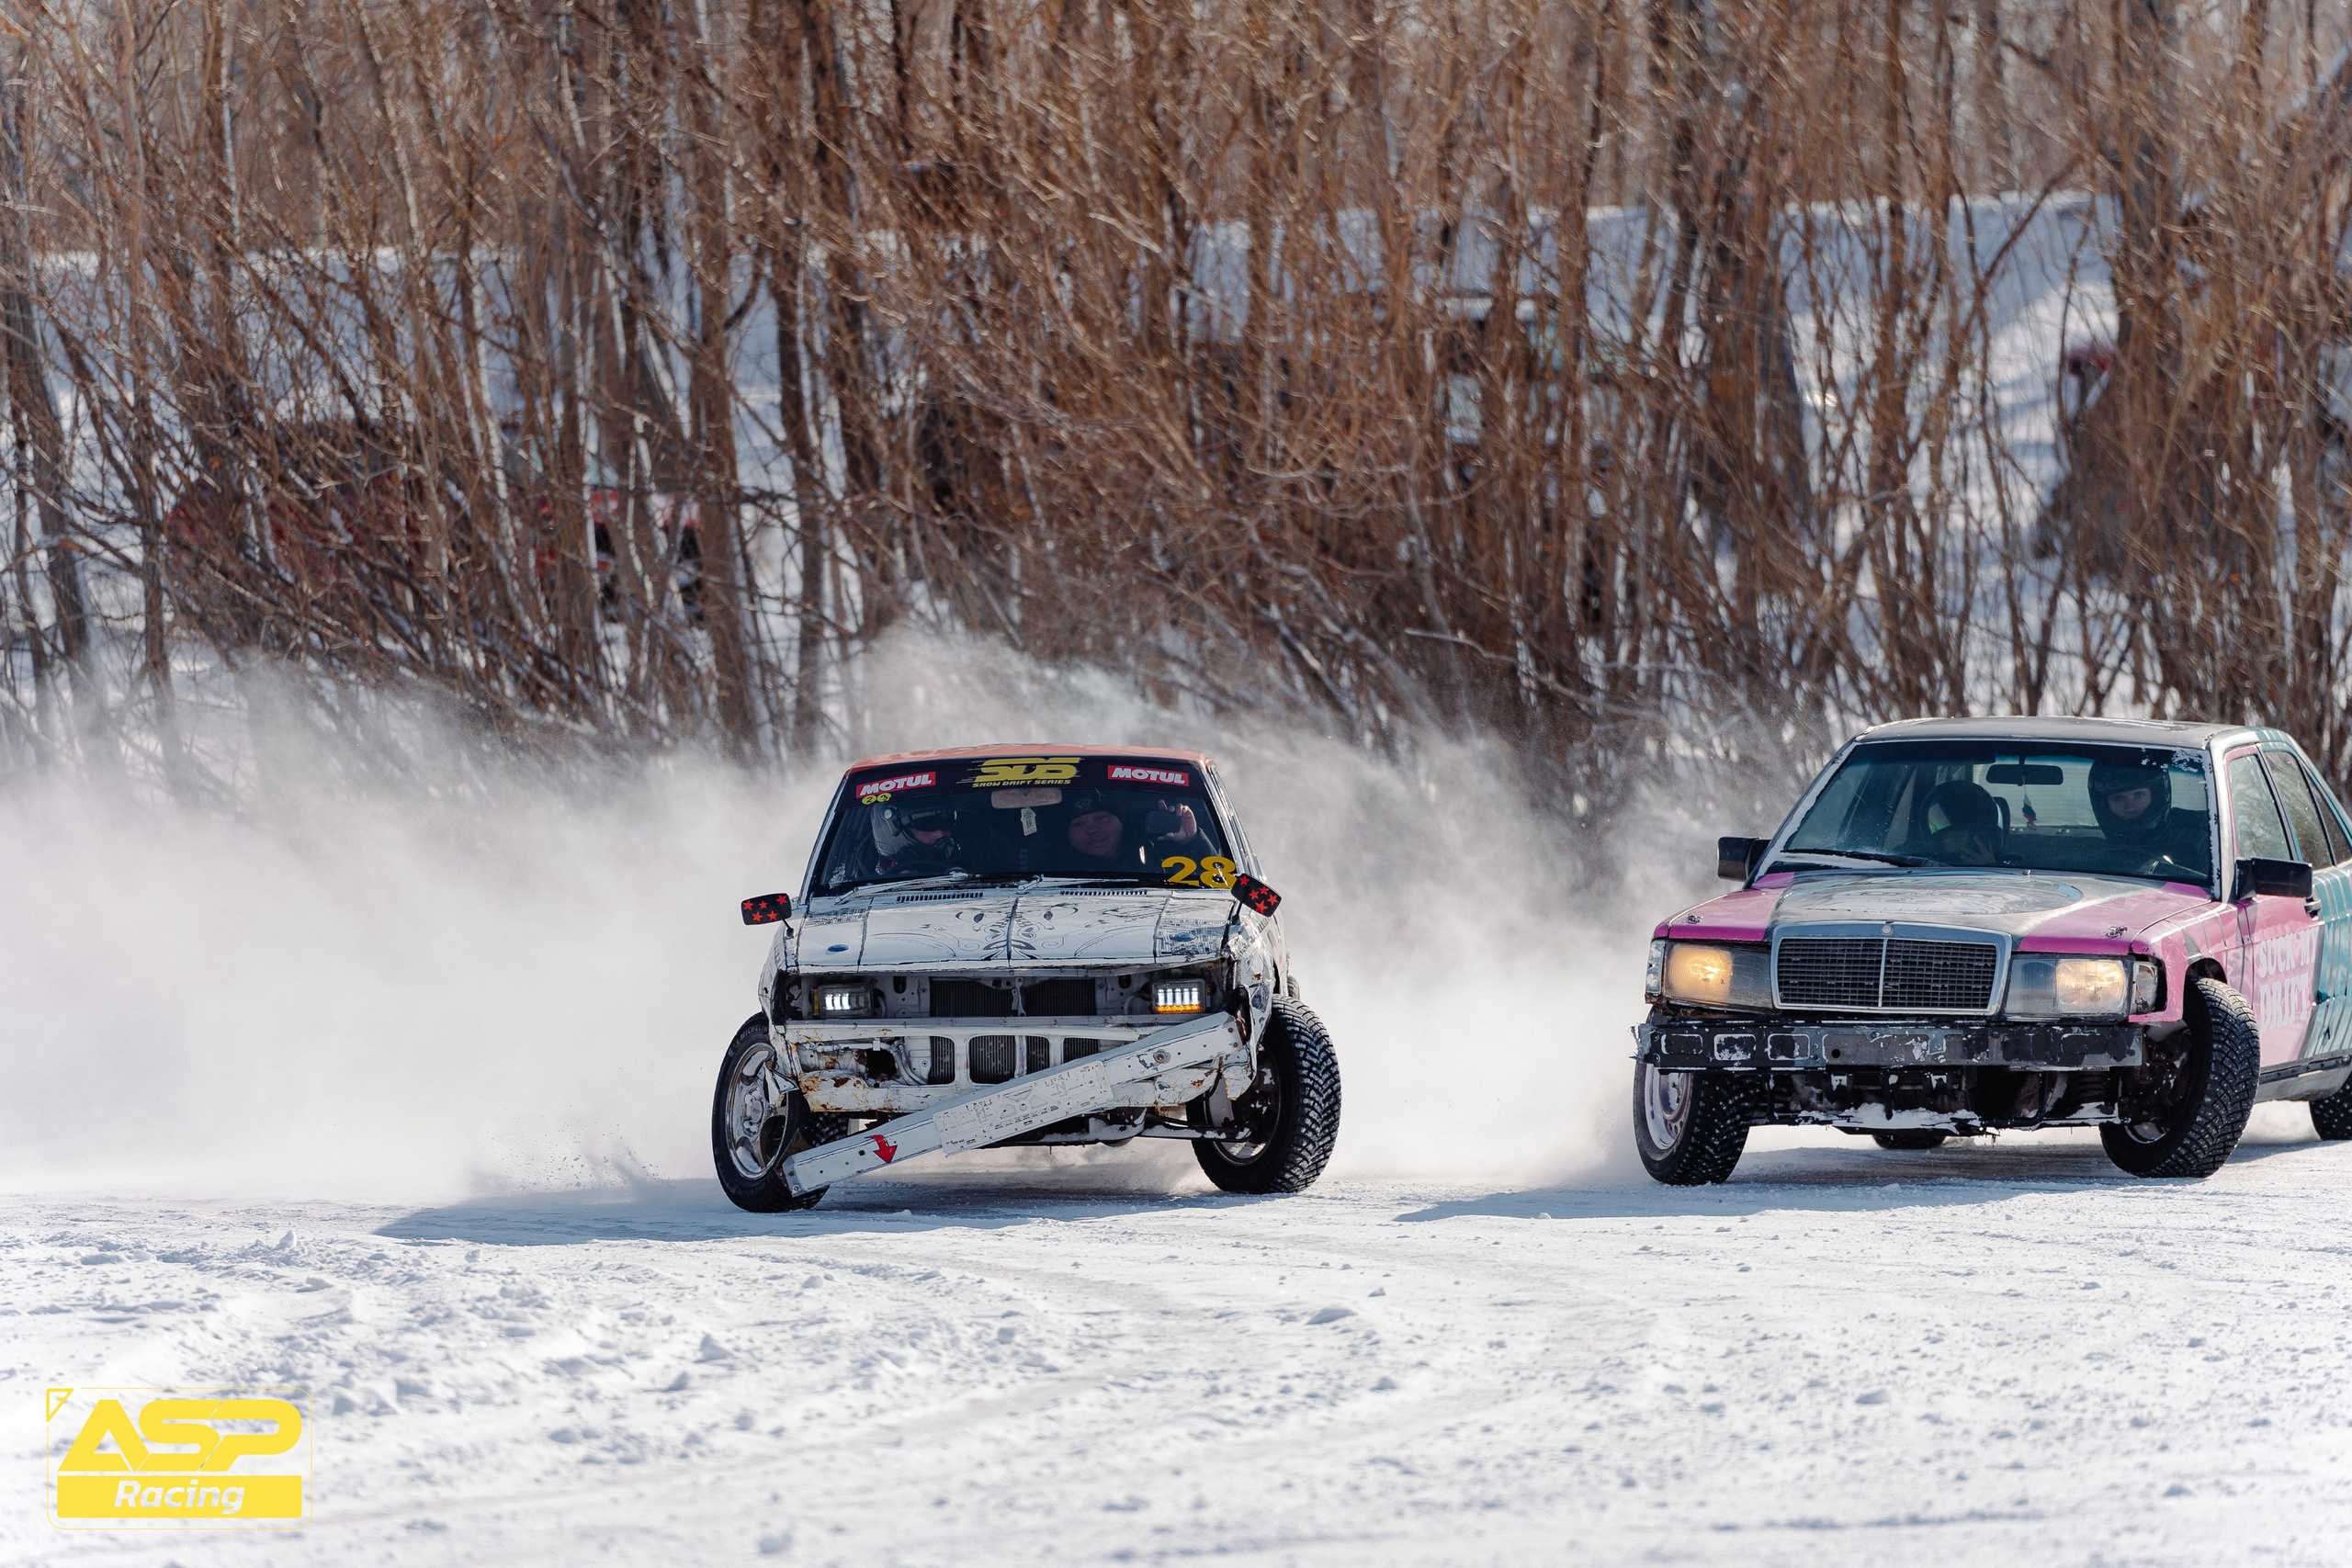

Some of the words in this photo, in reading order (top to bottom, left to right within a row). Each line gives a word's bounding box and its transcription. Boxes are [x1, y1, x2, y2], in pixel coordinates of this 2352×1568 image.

[859, 773, 933, 796] MOTUL
[1111, 767, 1186, 784] MOTUL
[1161, 856, 1237, 889] 28
[2258, 932, 2296, 978] SUCK
[2300, 926, 2320, 966] MY
[2258, 972, 2309, 1032] DRIFT
